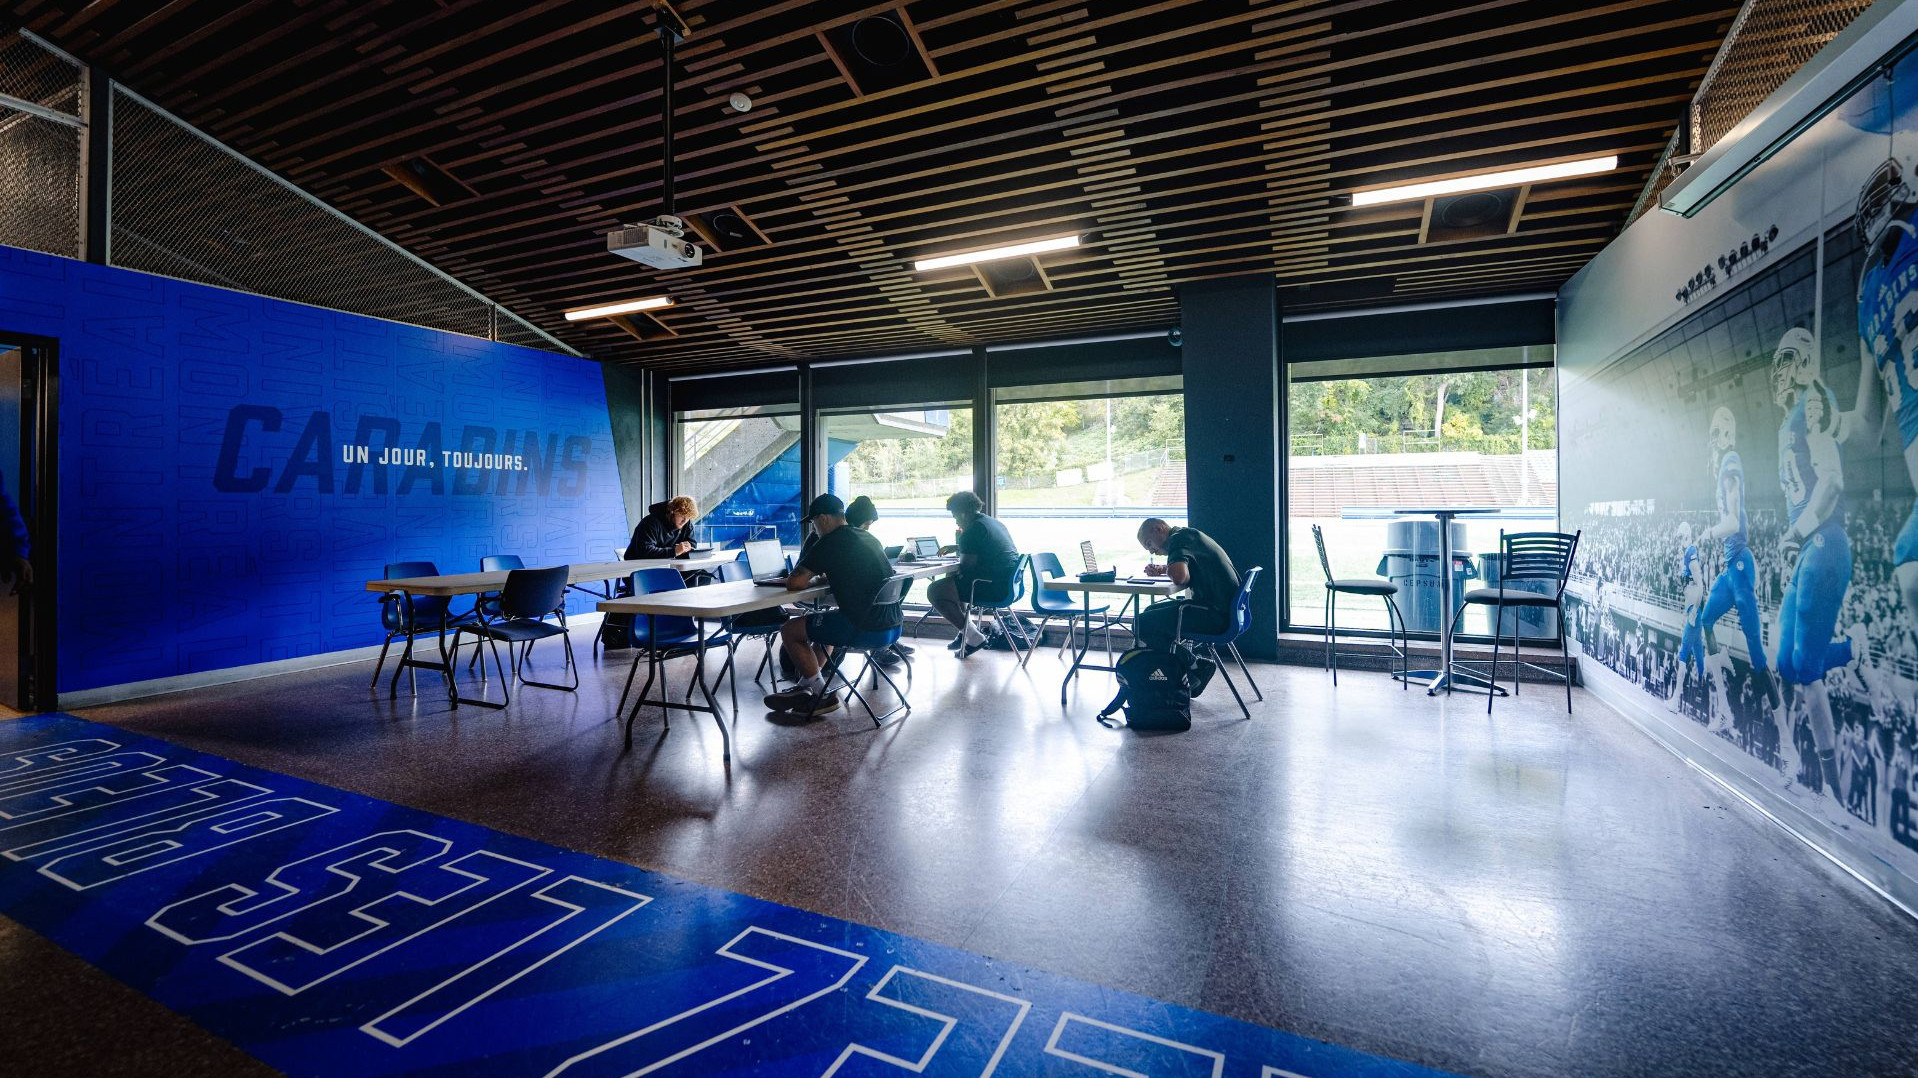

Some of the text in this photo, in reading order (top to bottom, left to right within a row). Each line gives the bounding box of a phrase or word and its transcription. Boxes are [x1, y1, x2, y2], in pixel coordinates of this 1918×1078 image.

[343, 444, 529, 472] UN JOUR, TOUJOURS.
[145, 829, 654, 1048] LES
